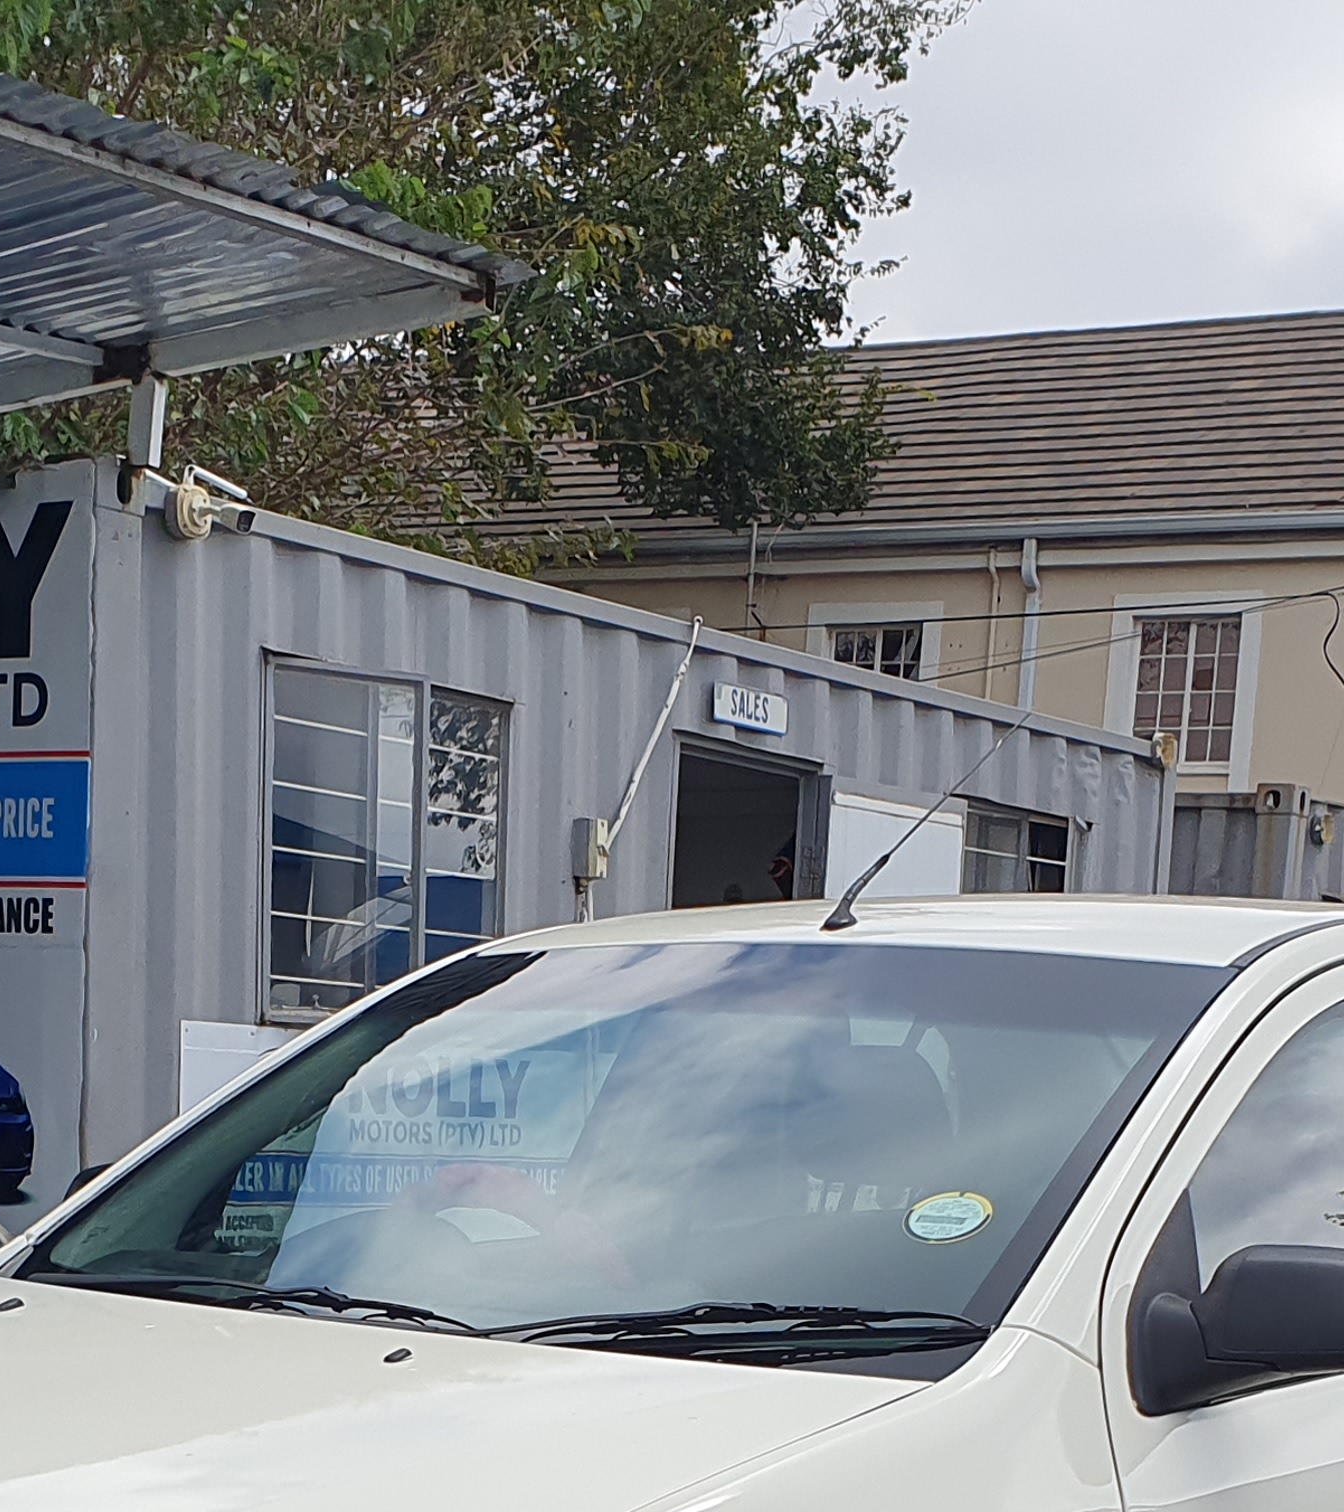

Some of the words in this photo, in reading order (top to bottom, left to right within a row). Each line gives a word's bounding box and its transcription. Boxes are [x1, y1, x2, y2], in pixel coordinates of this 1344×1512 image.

[731, 688, 769, 724] SALES
[348, 1055, 531, 1119] NOLLY
[348, 1119, 433, 1144] MOTORS
[438, 1120, 485, 1148] (PTY)
[490, 1122, 522, 1146] LTD
[365, 1164, 382, 1193] OF
